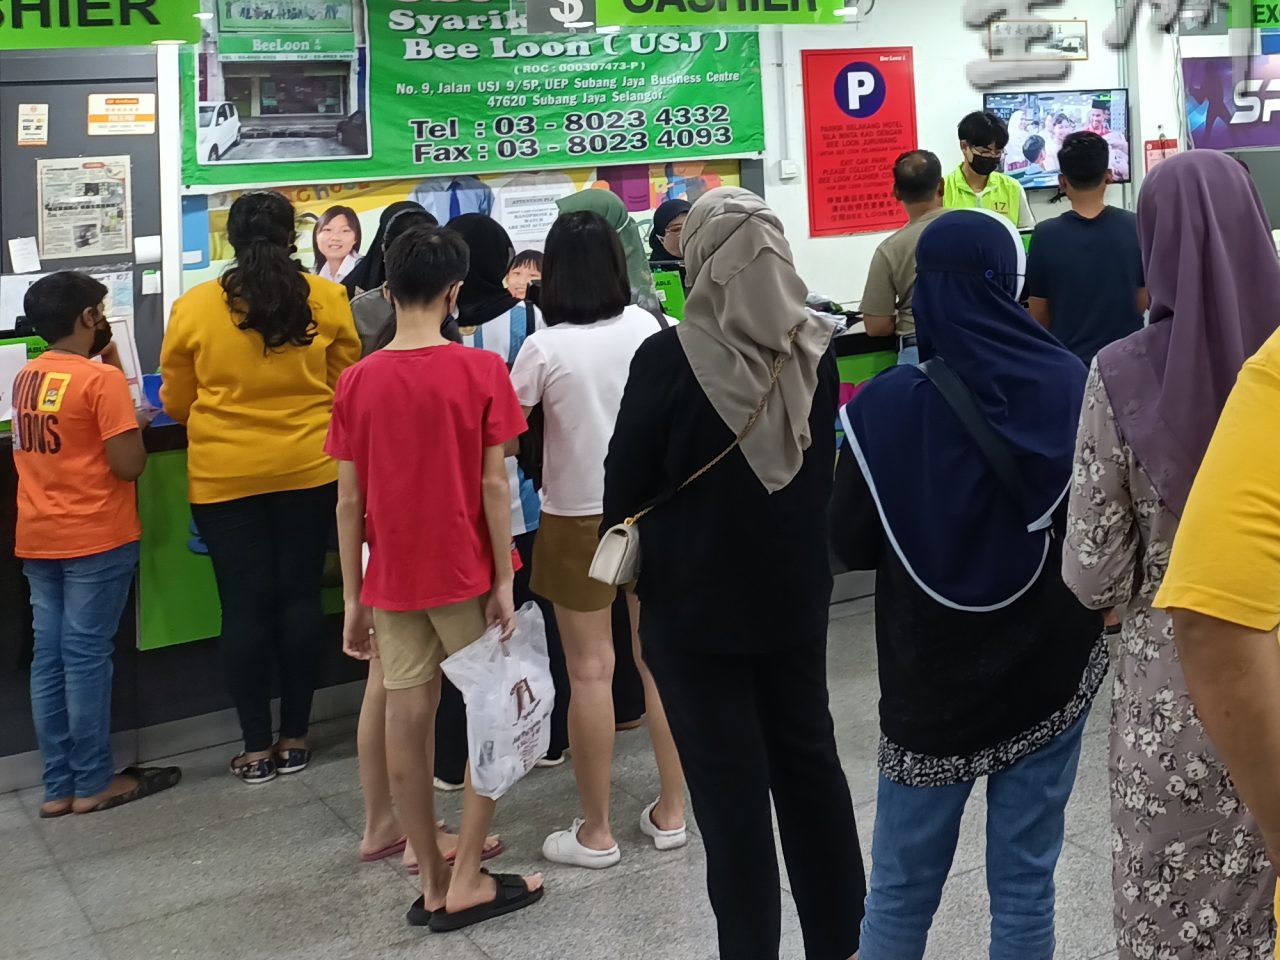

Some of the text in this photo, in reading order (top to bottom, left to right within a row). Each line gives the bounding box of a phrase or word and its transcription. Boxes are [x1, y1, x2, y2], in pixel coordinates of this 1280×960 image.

[252, 38, 310, 51] BeeLoon
[403, 38, 480, 61] Bee
[490, 36, 592, 59] Loon
[628, 31, 705, 54] USJ
[522, 63, 550, 73] ROC
[396, 83, 418, 95] No.
[437, 83, 471, 94] Jalan
[477, 81, 500, 93] USJ
[545, 78, 569, 90] UEP
[573, 77, 617, 90] Subang
[622, 76, 645, 89] Jaya
[650, 73, 702, 86] Business
[706, 71, 740, 83] Centre
[847, 71, 875, 110] P
[487, 95, 527, 108] 47620
[532, 94, 577, 107] Subang
[582, 92, 606, 105] Jaya
[409, 117, 459, 140] Tel
[494, 114, 537, 137] 03
[563, 109, 647, 133] 8023
[654, 104, 730, 127] 4332
[413, 141, 473, 164] Fax
[497, 137, 541, 160] 03
[566, 130, 650, 155] 8023
[655, 125, 733, 149] 4093
[993, 201, 1007, 211] 17
